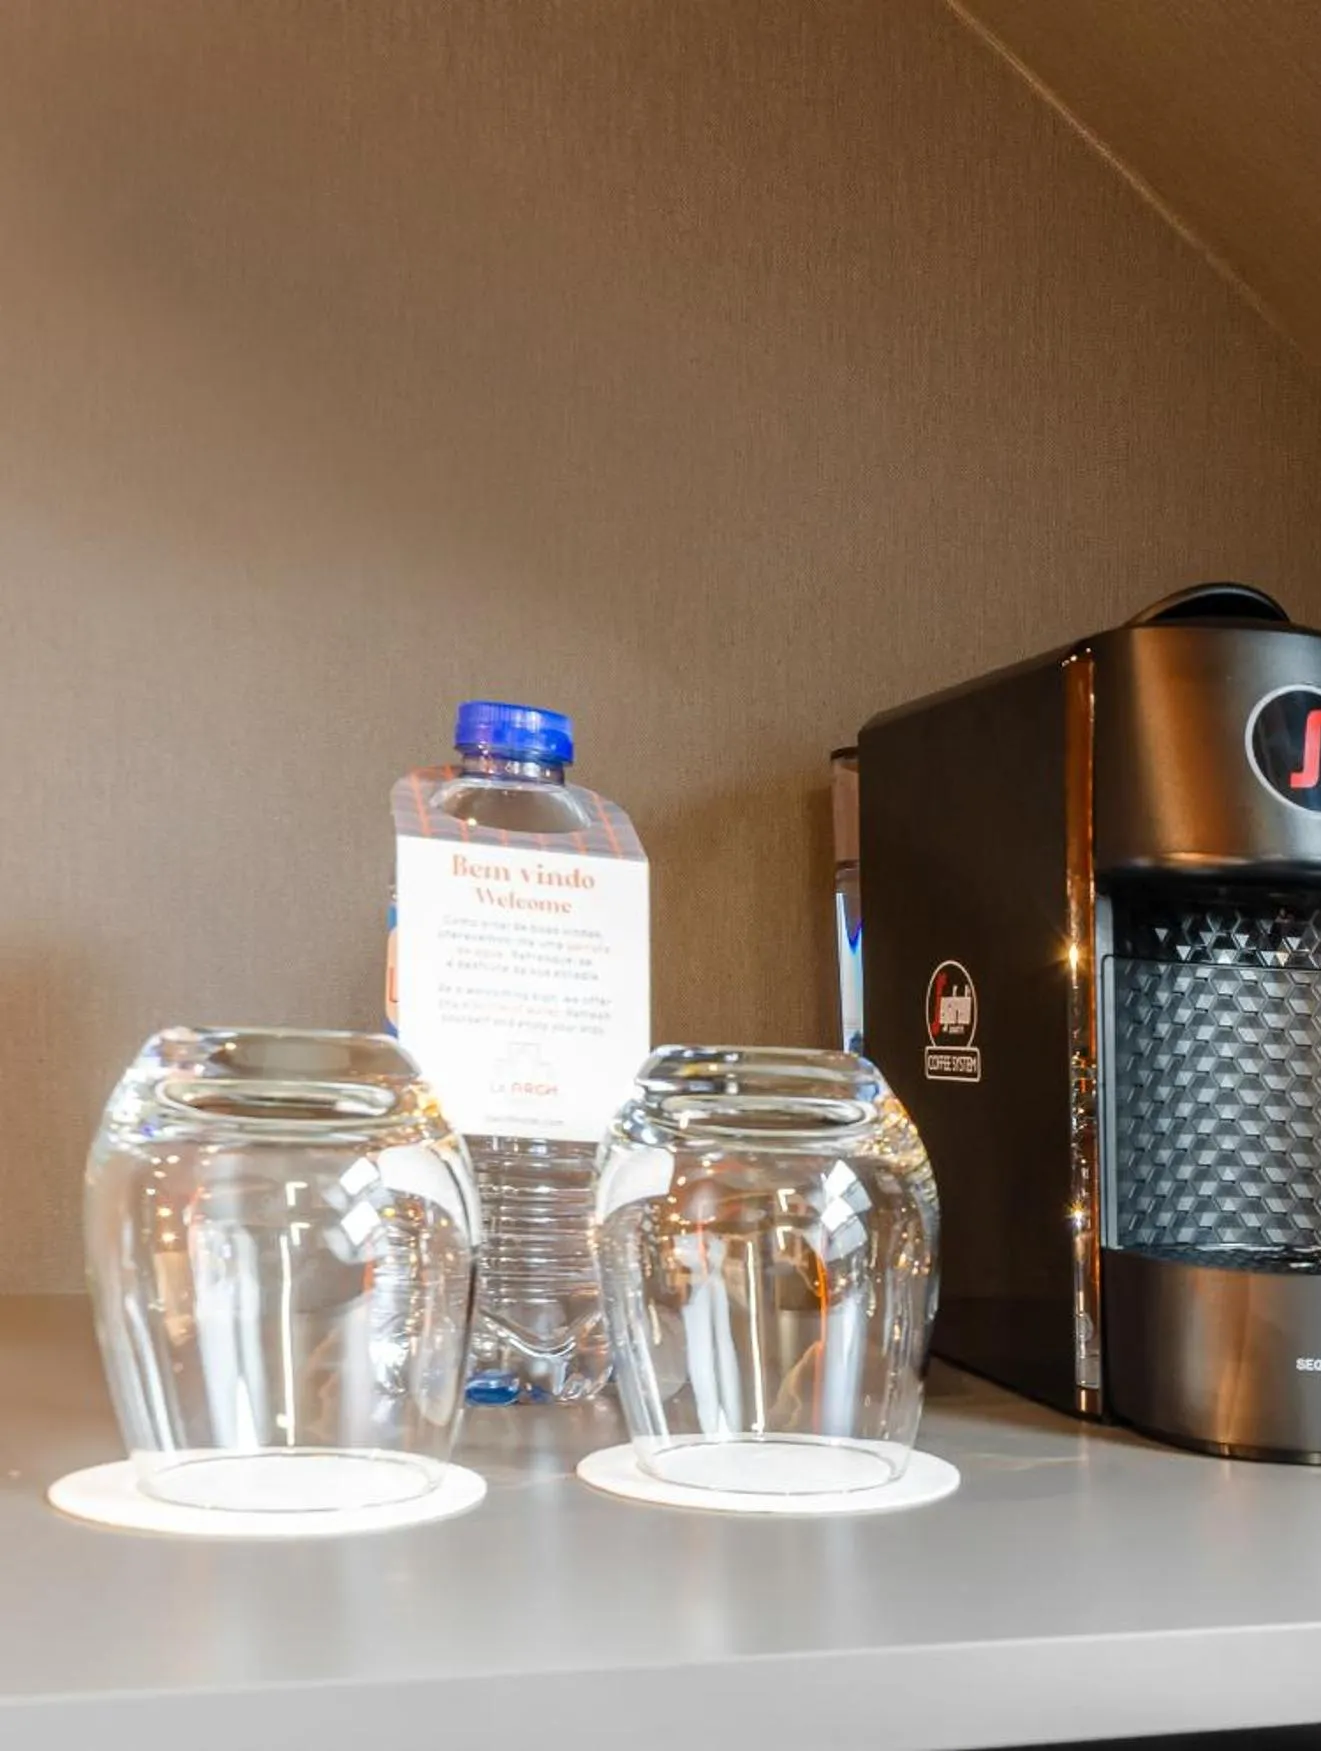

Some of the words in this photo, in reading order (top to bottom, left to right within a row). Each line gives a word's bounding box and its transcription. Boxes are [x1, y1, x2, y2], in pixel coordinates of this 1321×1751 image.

[452, 853, 511, 882] Bem
[520, 863, 596, 890] vindo
[475, 887, 573, 914] Welcome
[928, 1055, 951, 1071] COFFEE
[952, 1056, 977, 1073] SYSTEM
